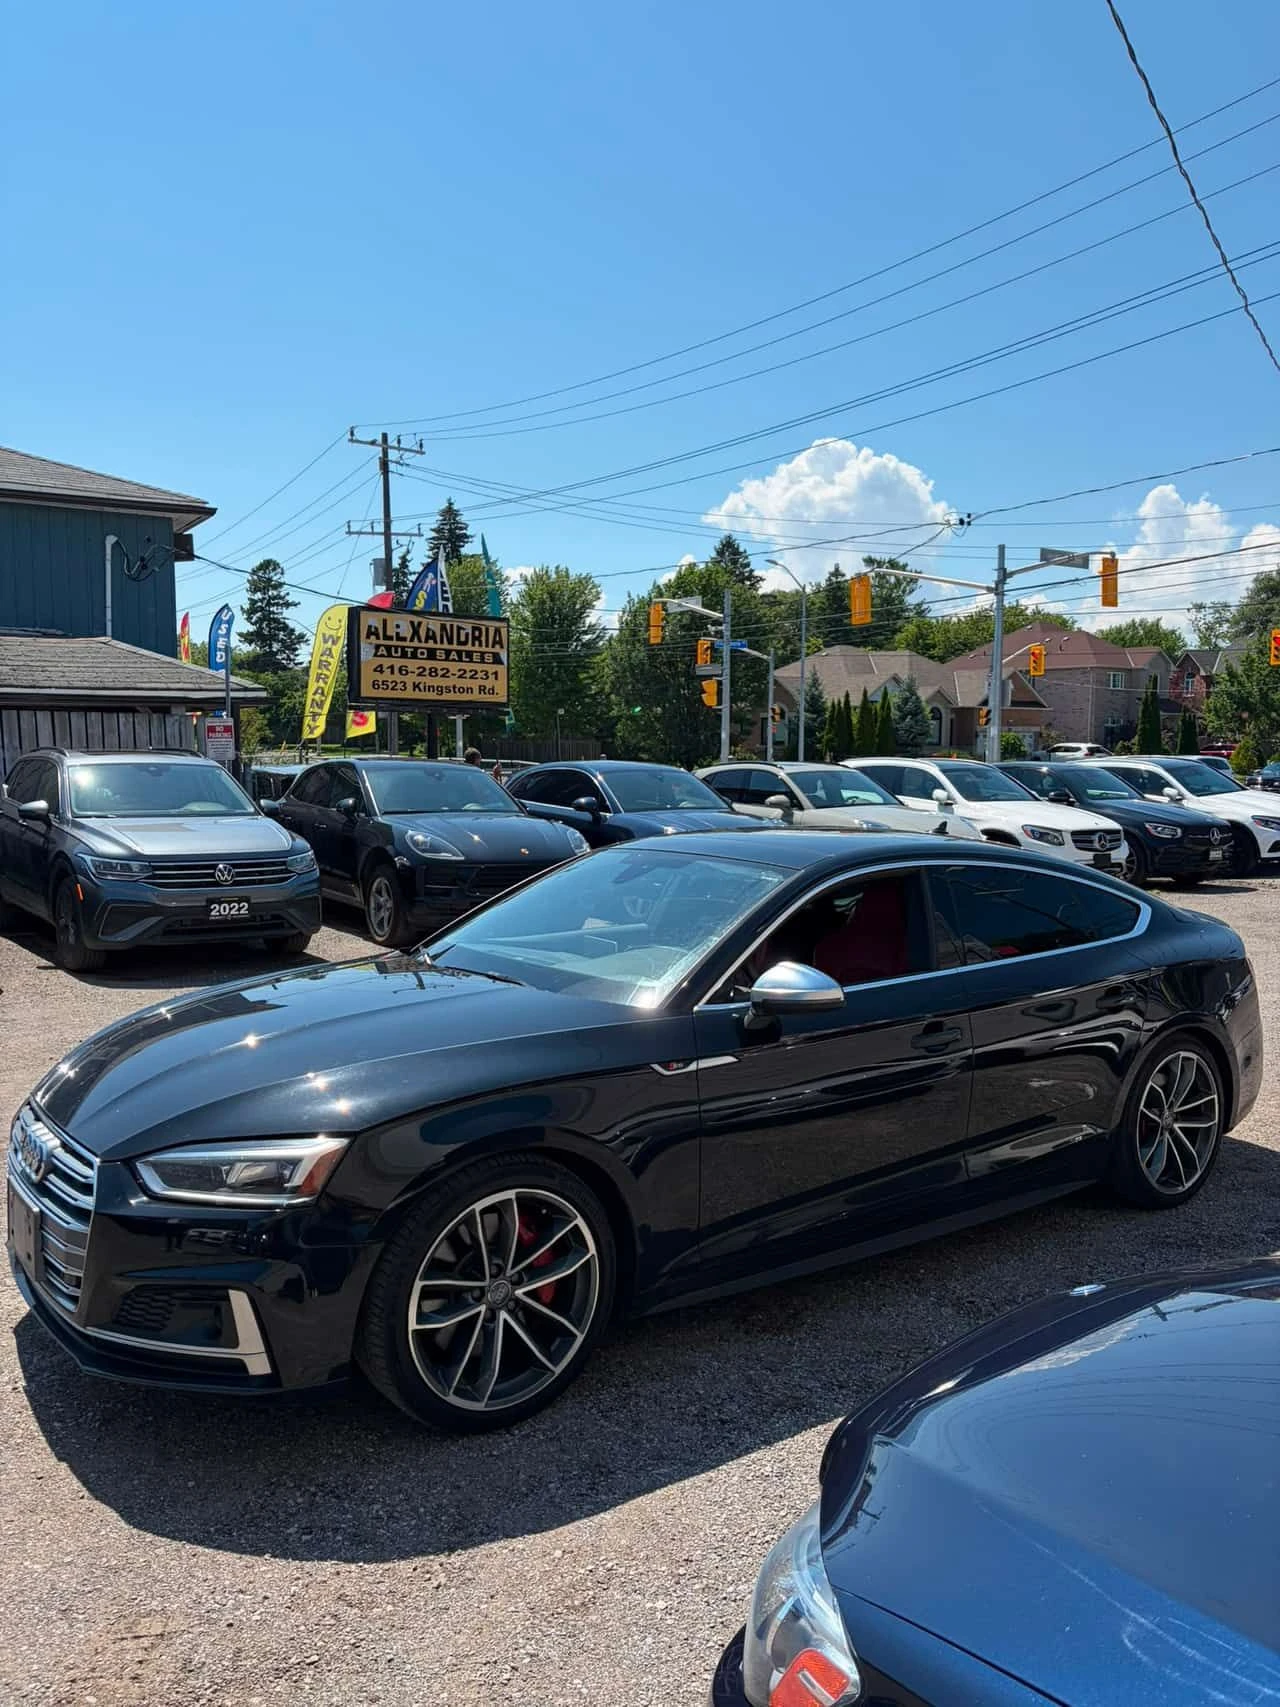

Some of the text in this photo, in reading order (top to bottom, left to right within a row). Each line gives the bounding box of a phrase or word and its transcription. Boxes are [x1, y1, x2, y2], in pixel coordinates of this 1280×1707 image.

[216, 608, 232, 663] USED
[377, 646, 494, 663] AUTO SALES
[373, 664, 499, 681] 416-282-2231
[307, 632, 341, 735] WARRANTY
[371, 679, 499, 697] 6523 Kingston Rd.
[210, 902, 249, 916] 2022
